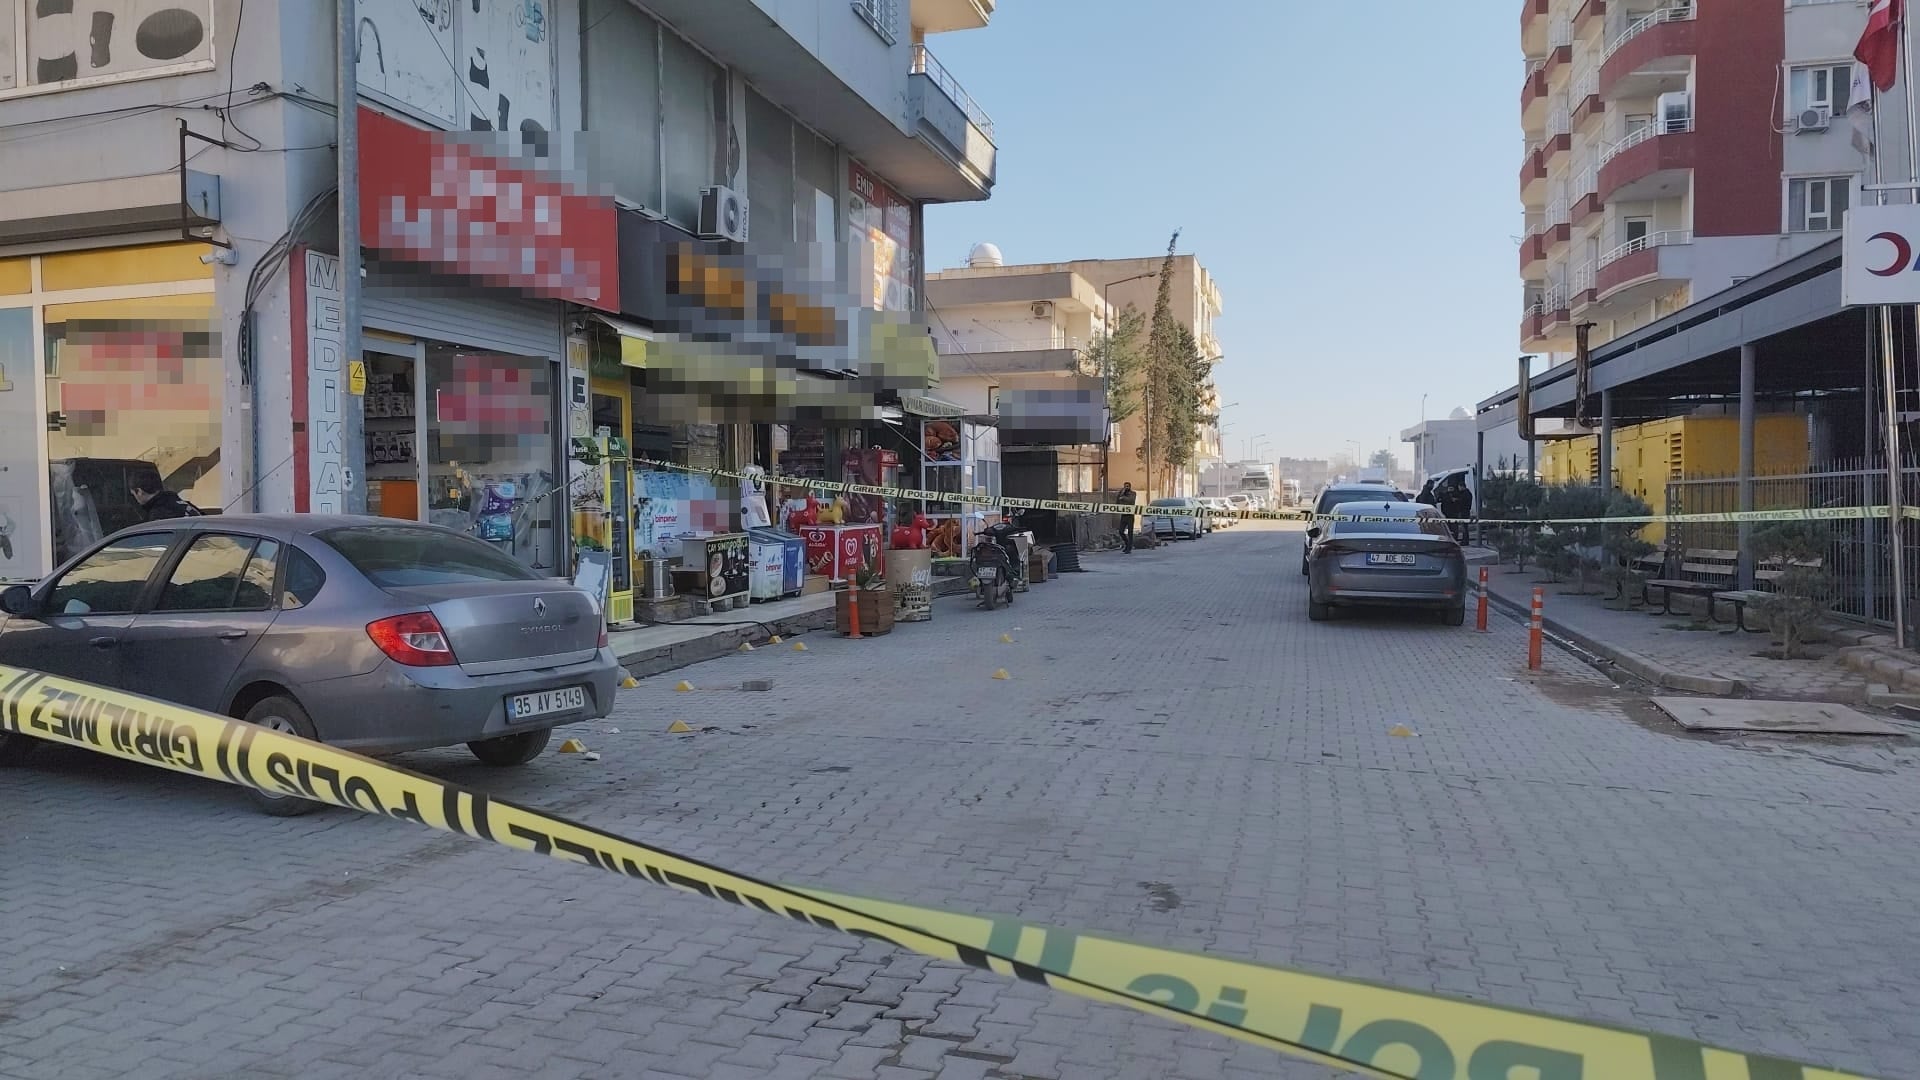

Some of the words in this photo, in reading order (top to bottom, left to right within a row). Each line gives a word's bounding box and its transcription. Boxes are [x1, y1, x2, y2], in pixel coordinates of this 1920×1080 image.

[852, 484, 896, 496] GİRİLMEZ
[947, 494, 991, 504] GİRİLMEZ
[1044, 502, 1090, 511] GİRİLMEZ
[1145, 507, 1193, 516] GİRİLMEZ
[1252, 512, 1302, 520] GİRİLMEZ
[515, 697, 531, 715] 35
[538, 694, 551, 712] AV
[555, 690, 583, 709] 5149
